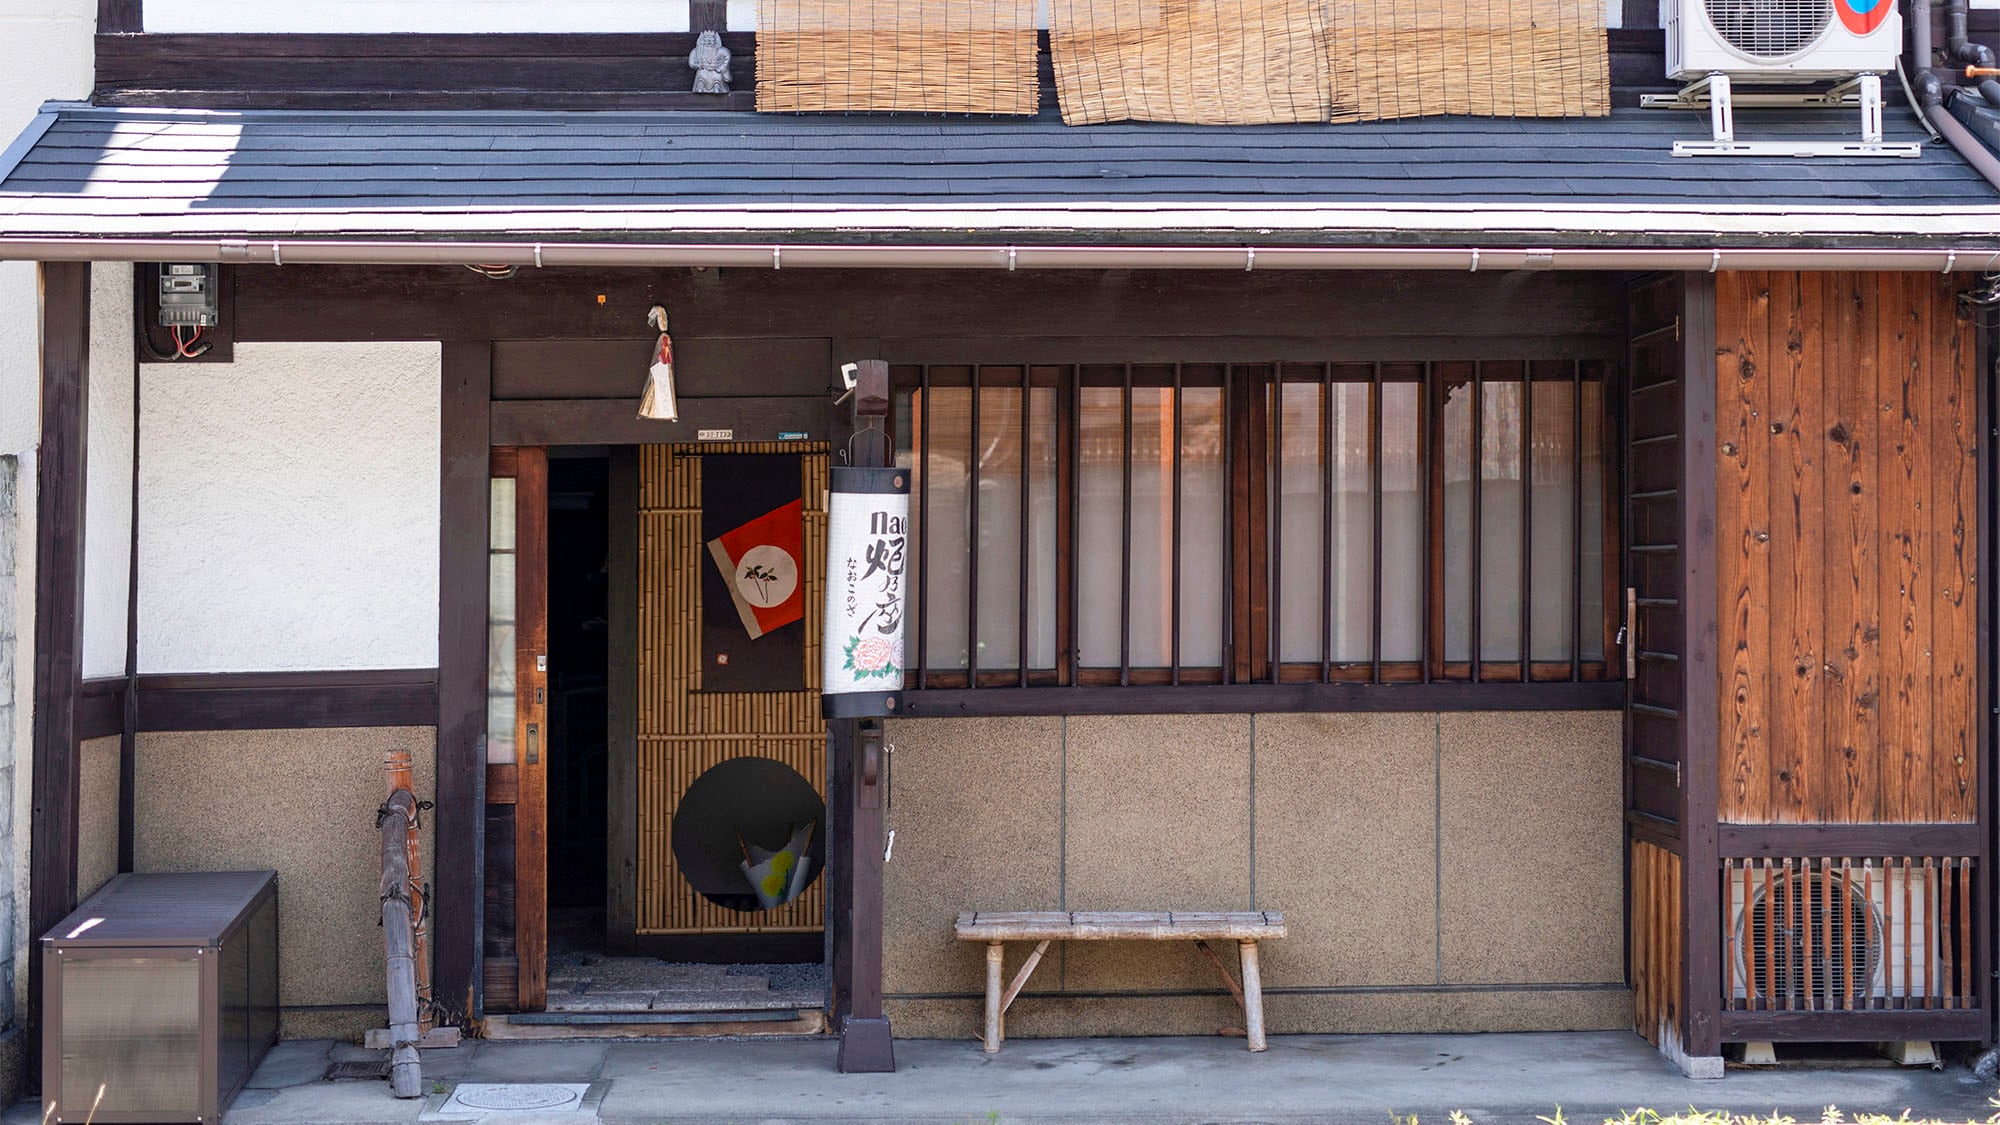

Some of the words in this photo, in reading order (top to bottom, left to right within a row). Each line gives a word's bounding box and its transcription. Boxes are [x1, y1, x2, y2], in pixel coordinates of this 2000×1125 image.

[846, 557, 858, 618] なおこのざ
